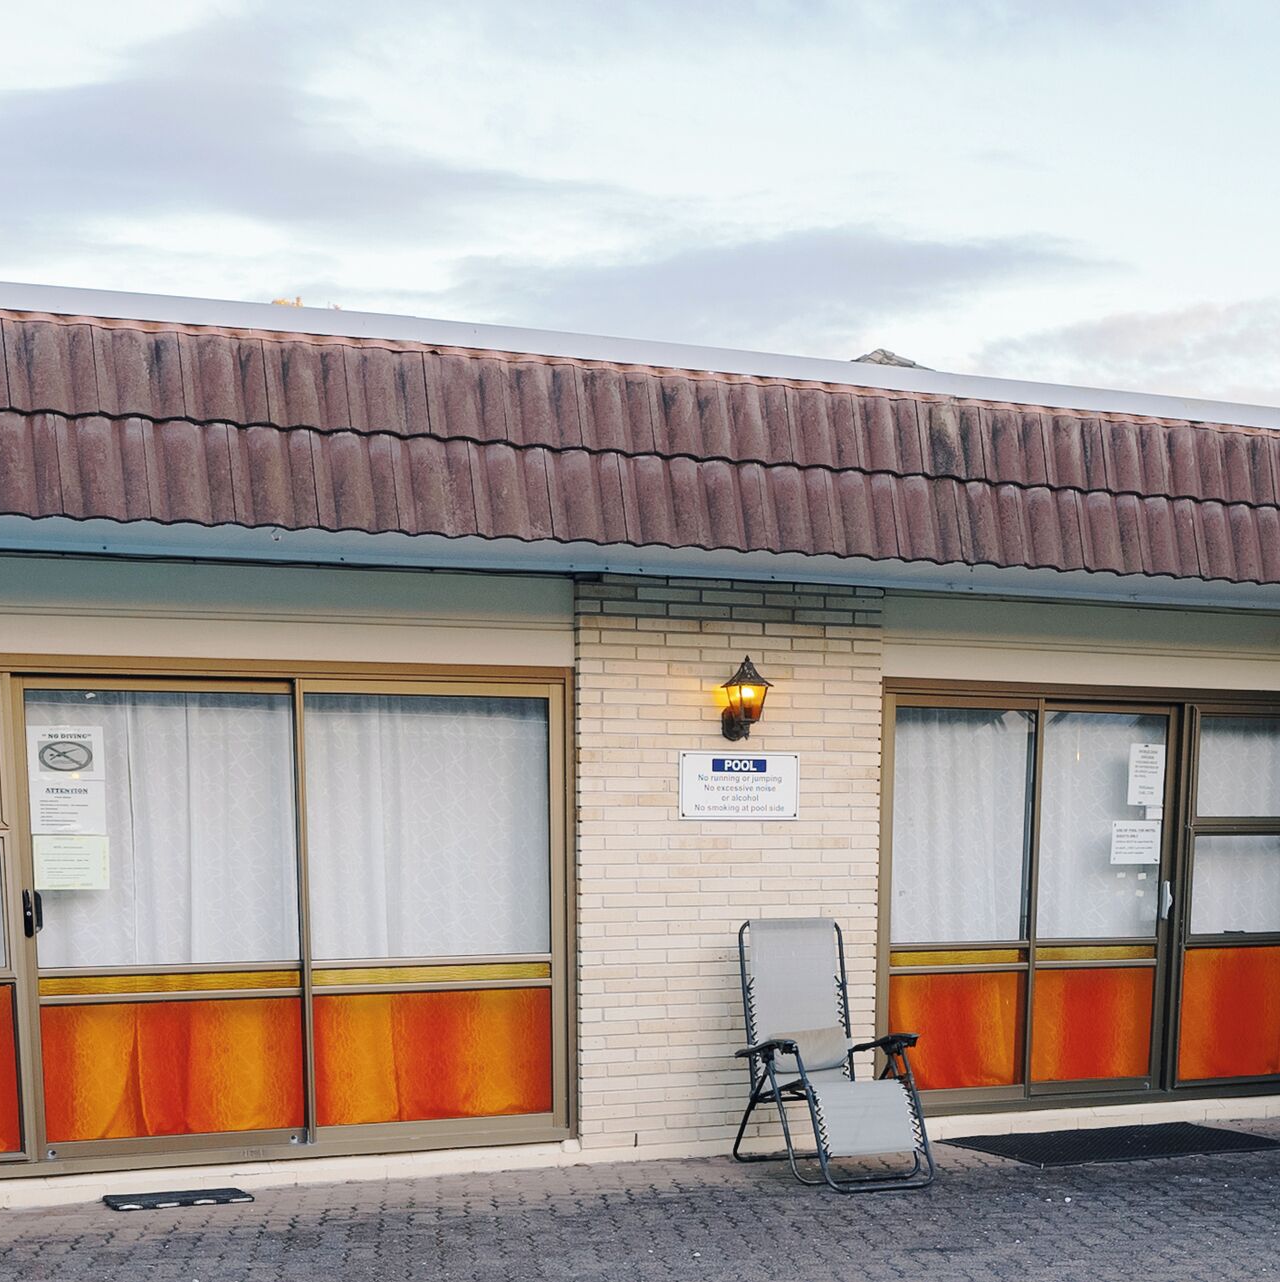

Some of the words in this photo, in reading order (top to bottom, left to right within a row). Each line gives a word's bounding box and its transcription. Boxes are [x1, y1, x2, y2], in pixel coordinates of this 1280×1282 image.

[724, 760, 757, 771] POOL
[710, 774, 740, 783] running
[751, 774, 783, 784] jumping
[45, 787, 89, 795] ATTENTION
[704, 784, 715, 792] No
[716, 784, 754, 792] excessive
[755, 784, 777, 792] noise
[731, 794, 760, 802] alcohol
[707, 804, 740, 813] smoking
[741, 804, 749, 812] at
[751, 804, 768, 813] pool
[769, 804, 785, 812] side
